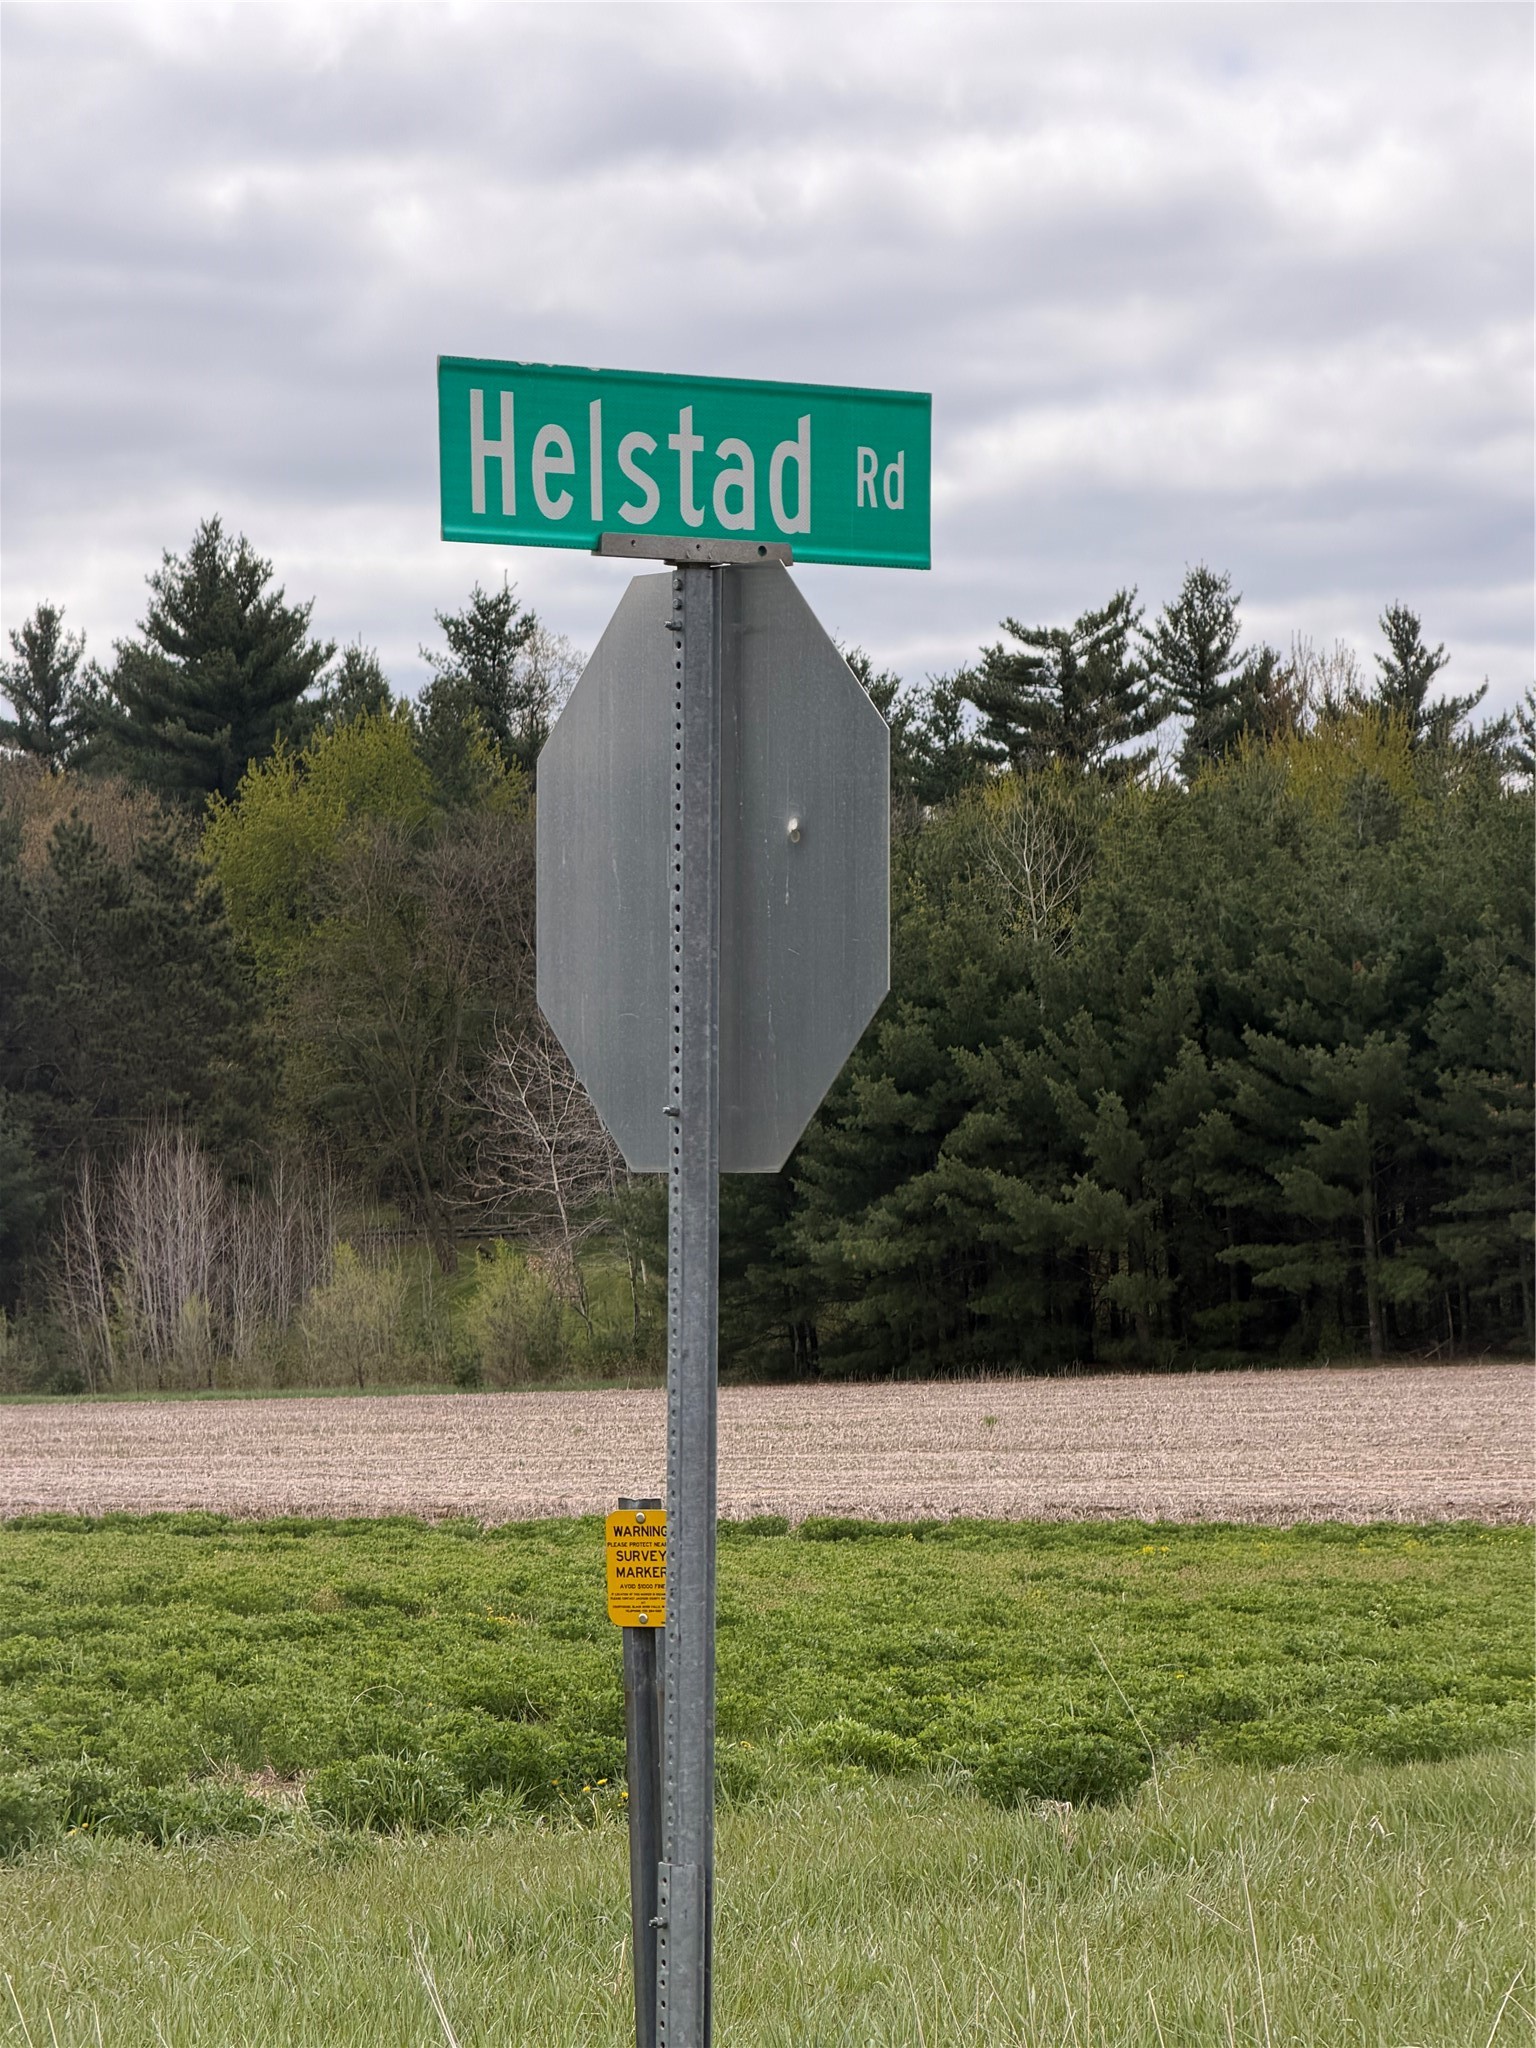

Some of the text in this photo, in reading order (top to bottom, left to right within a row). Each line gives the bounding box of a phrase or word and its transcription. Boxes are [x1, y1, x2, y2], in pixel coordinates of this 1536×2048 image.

[469, 388, 905, 535] Helstad Rd
[613, 1525, 667, 1537] WARNING
[616, 1550, 667, 1562] SURVEY
